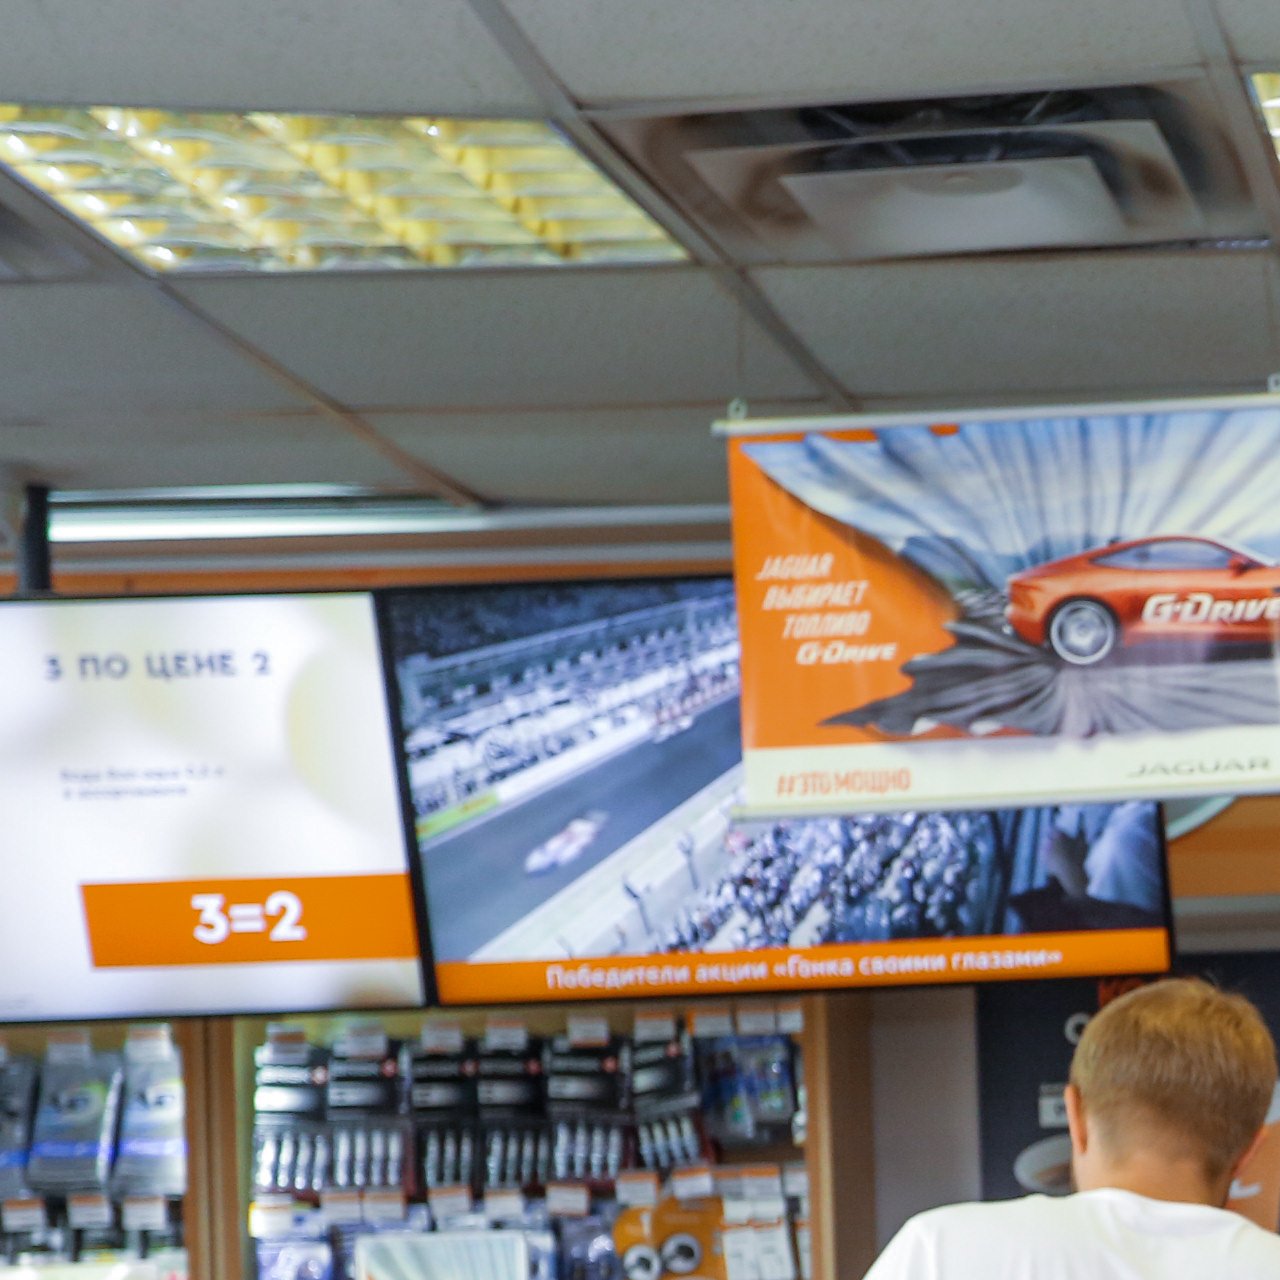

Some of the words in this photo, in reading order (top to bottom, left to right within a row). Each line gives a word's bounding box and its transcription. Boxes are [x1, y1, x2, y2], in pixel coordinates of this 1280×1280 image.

[79, 655, 129, 681] ПО
[146, 652, 238, 684] ЦЕНЕ
[253, 651, 272, 678] 2
[1128, 755, 1272, 778] JAGUAR
[192, 890, 306, 944] 3=2
[546, 964, 689, 990] Победители
[695, 961, 768, 984] акции
[859, 953, 946, 976] своими
